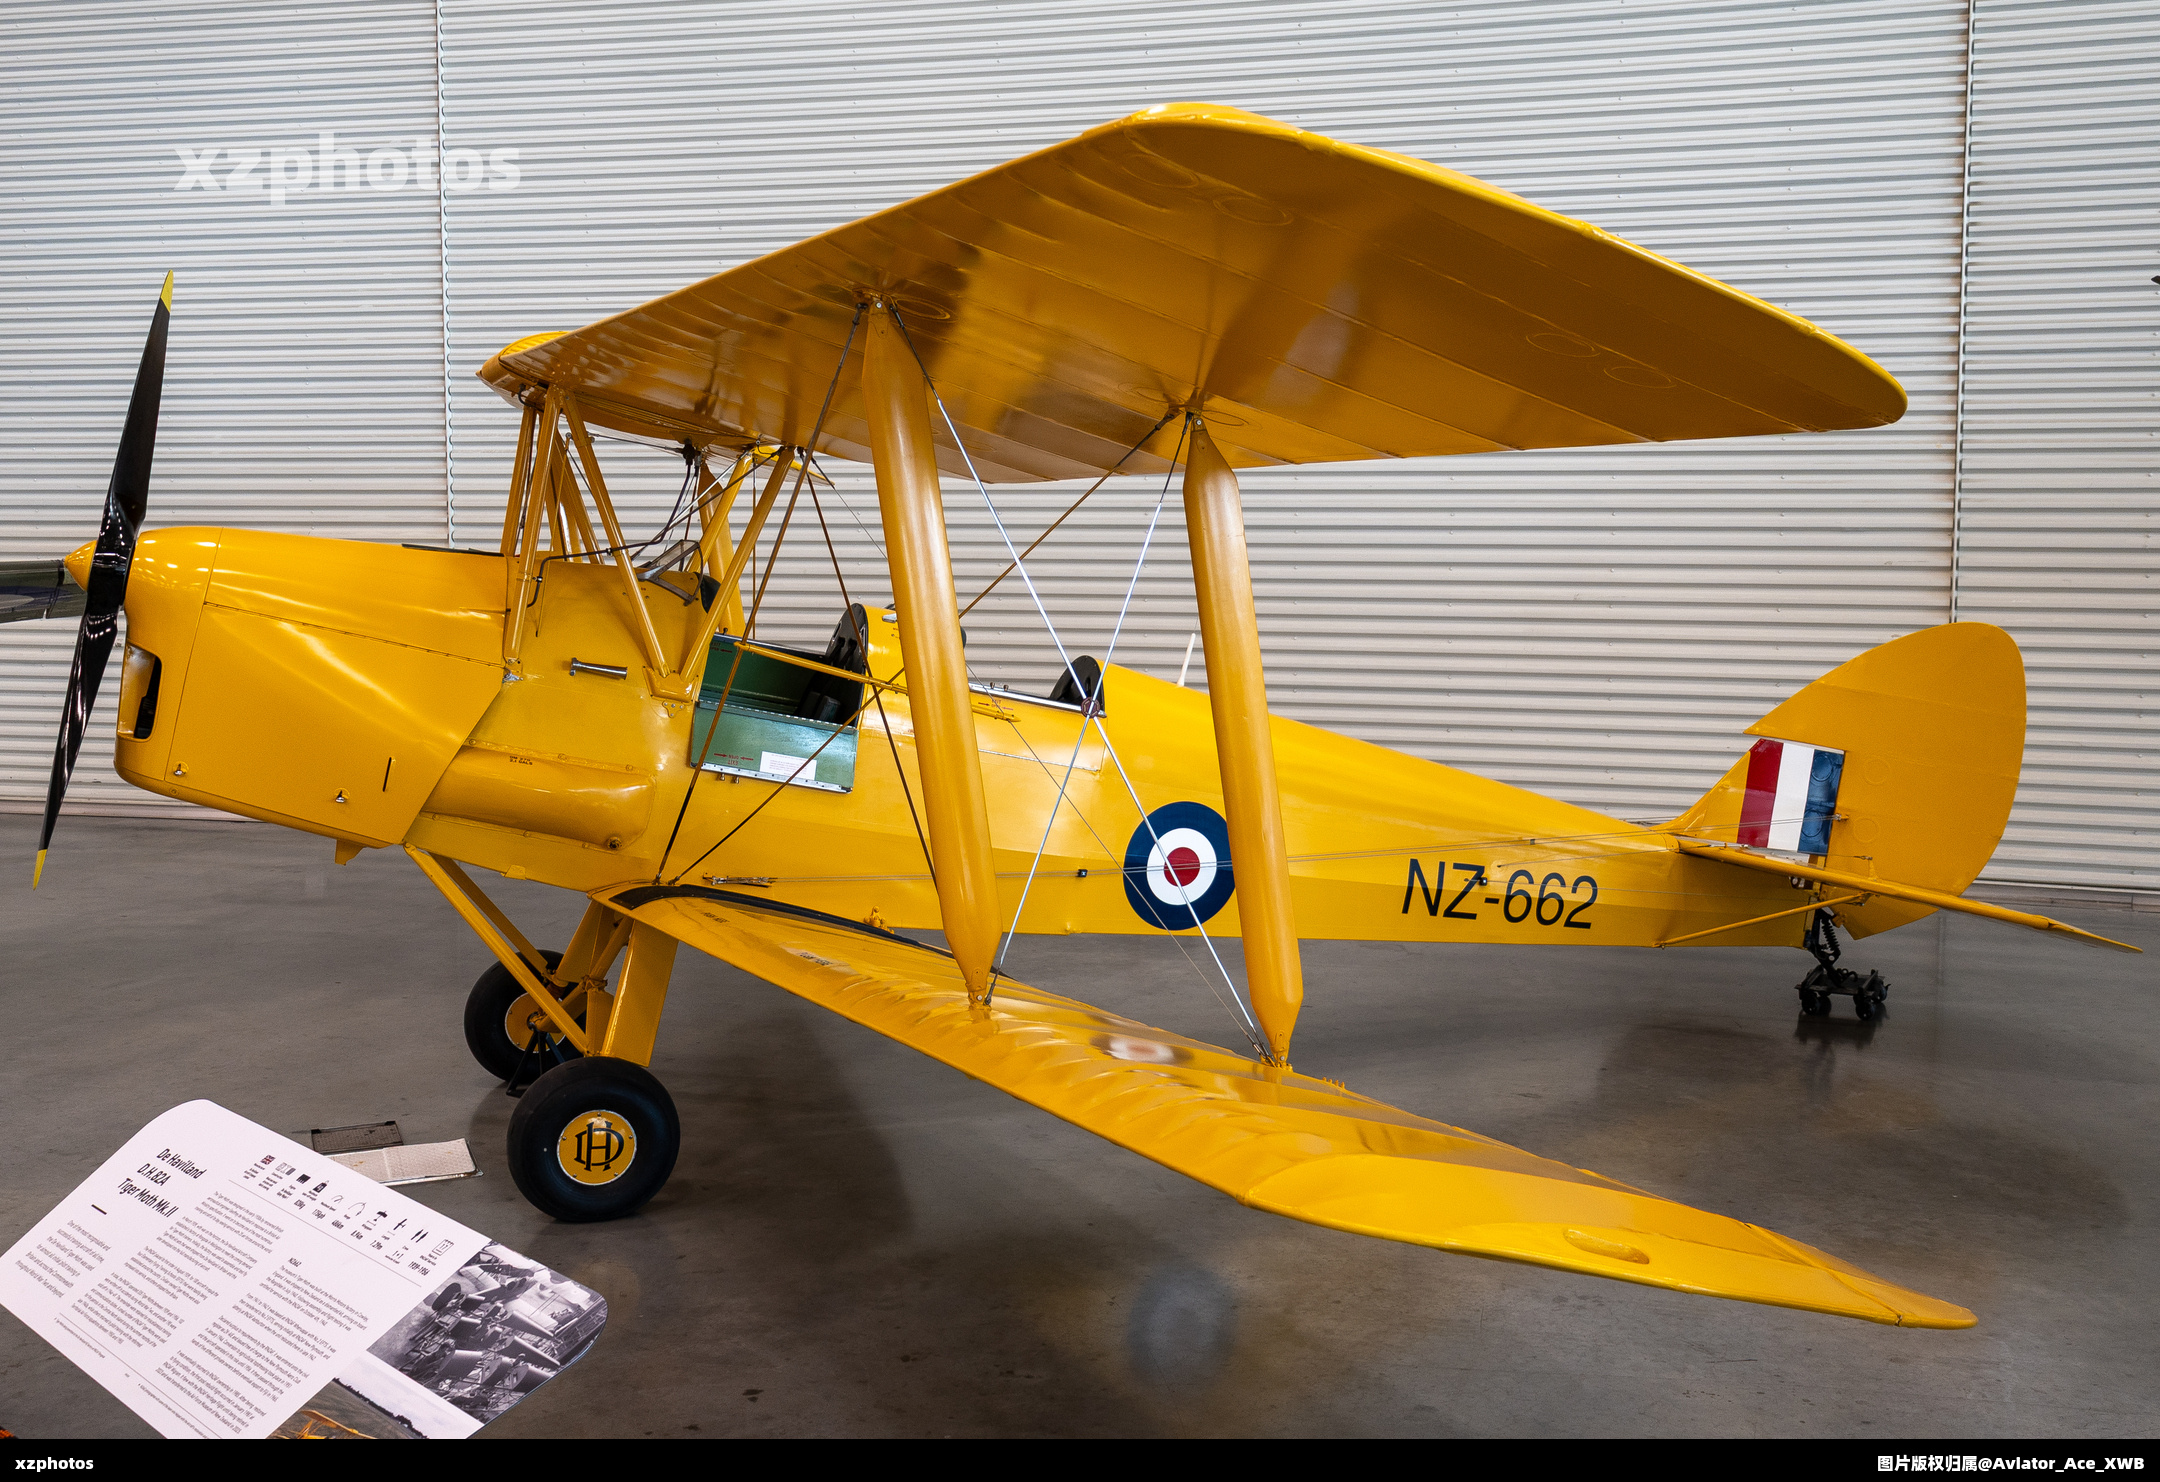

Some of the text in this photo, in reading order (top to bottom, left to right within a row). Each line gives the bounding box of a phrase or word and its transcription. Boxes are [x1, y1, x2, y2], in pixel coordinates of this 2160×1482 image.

[1402, 858, 1599, 929] NZ-662
[137, 1163, 171, 1186] D.H.82A
[156, 1148, 207, 1179] De Havilland
[118, 1178, 179, 1217] Tiger Moth Mk.II
